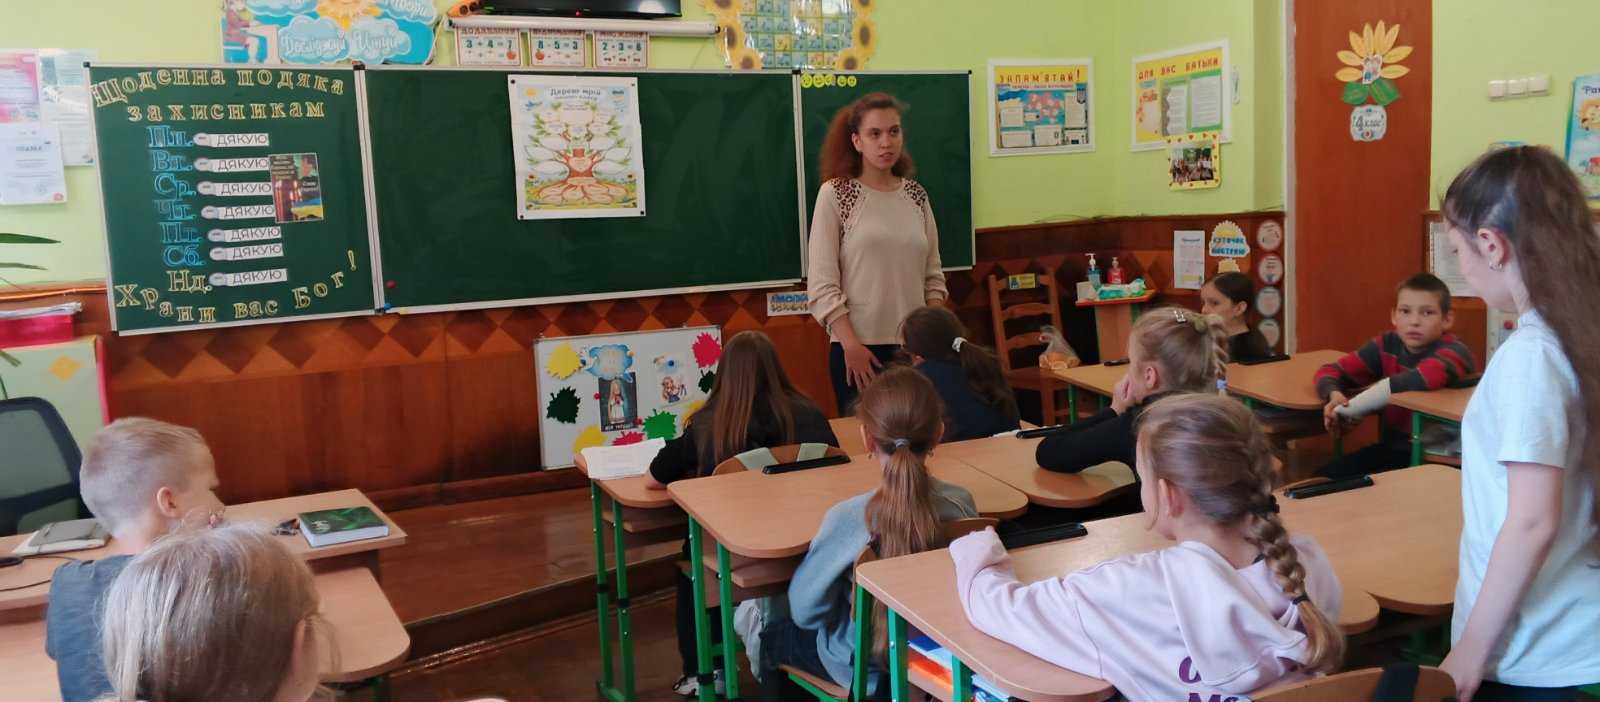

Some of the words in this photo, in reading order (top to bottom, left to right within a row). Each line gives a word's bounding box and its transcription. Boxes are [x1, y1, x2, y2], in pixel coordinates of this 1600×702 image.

[91, 69, 226, 107] Щоденна
[236, 70, 345, 95] подяка
[127, 101, 325, 122] захисникам
[1355, 115, 1364, 131] 4
[217, 134, 267, 146] ДЯКУЮ
[218, 159, 268, 170] ДЯКУЮ
[154, 173, 197, 200] Ср.
[221, 182, 271, 194] ДЯКУЮ
[224, 206, 274, 218] ДЯКУЮ
[231, 228, 280, 240] ДЯКУЮ
[164, 245, 206, 267] Сб.
[233, 244, 282, 257] ДЯКУЮ
[168, 270, 213, 294] Нд.
[232, 270, 282, 283] ДЯКУЮ
[114, 284, 216, 322] Храни
[233, 300, 278, 318] вас
